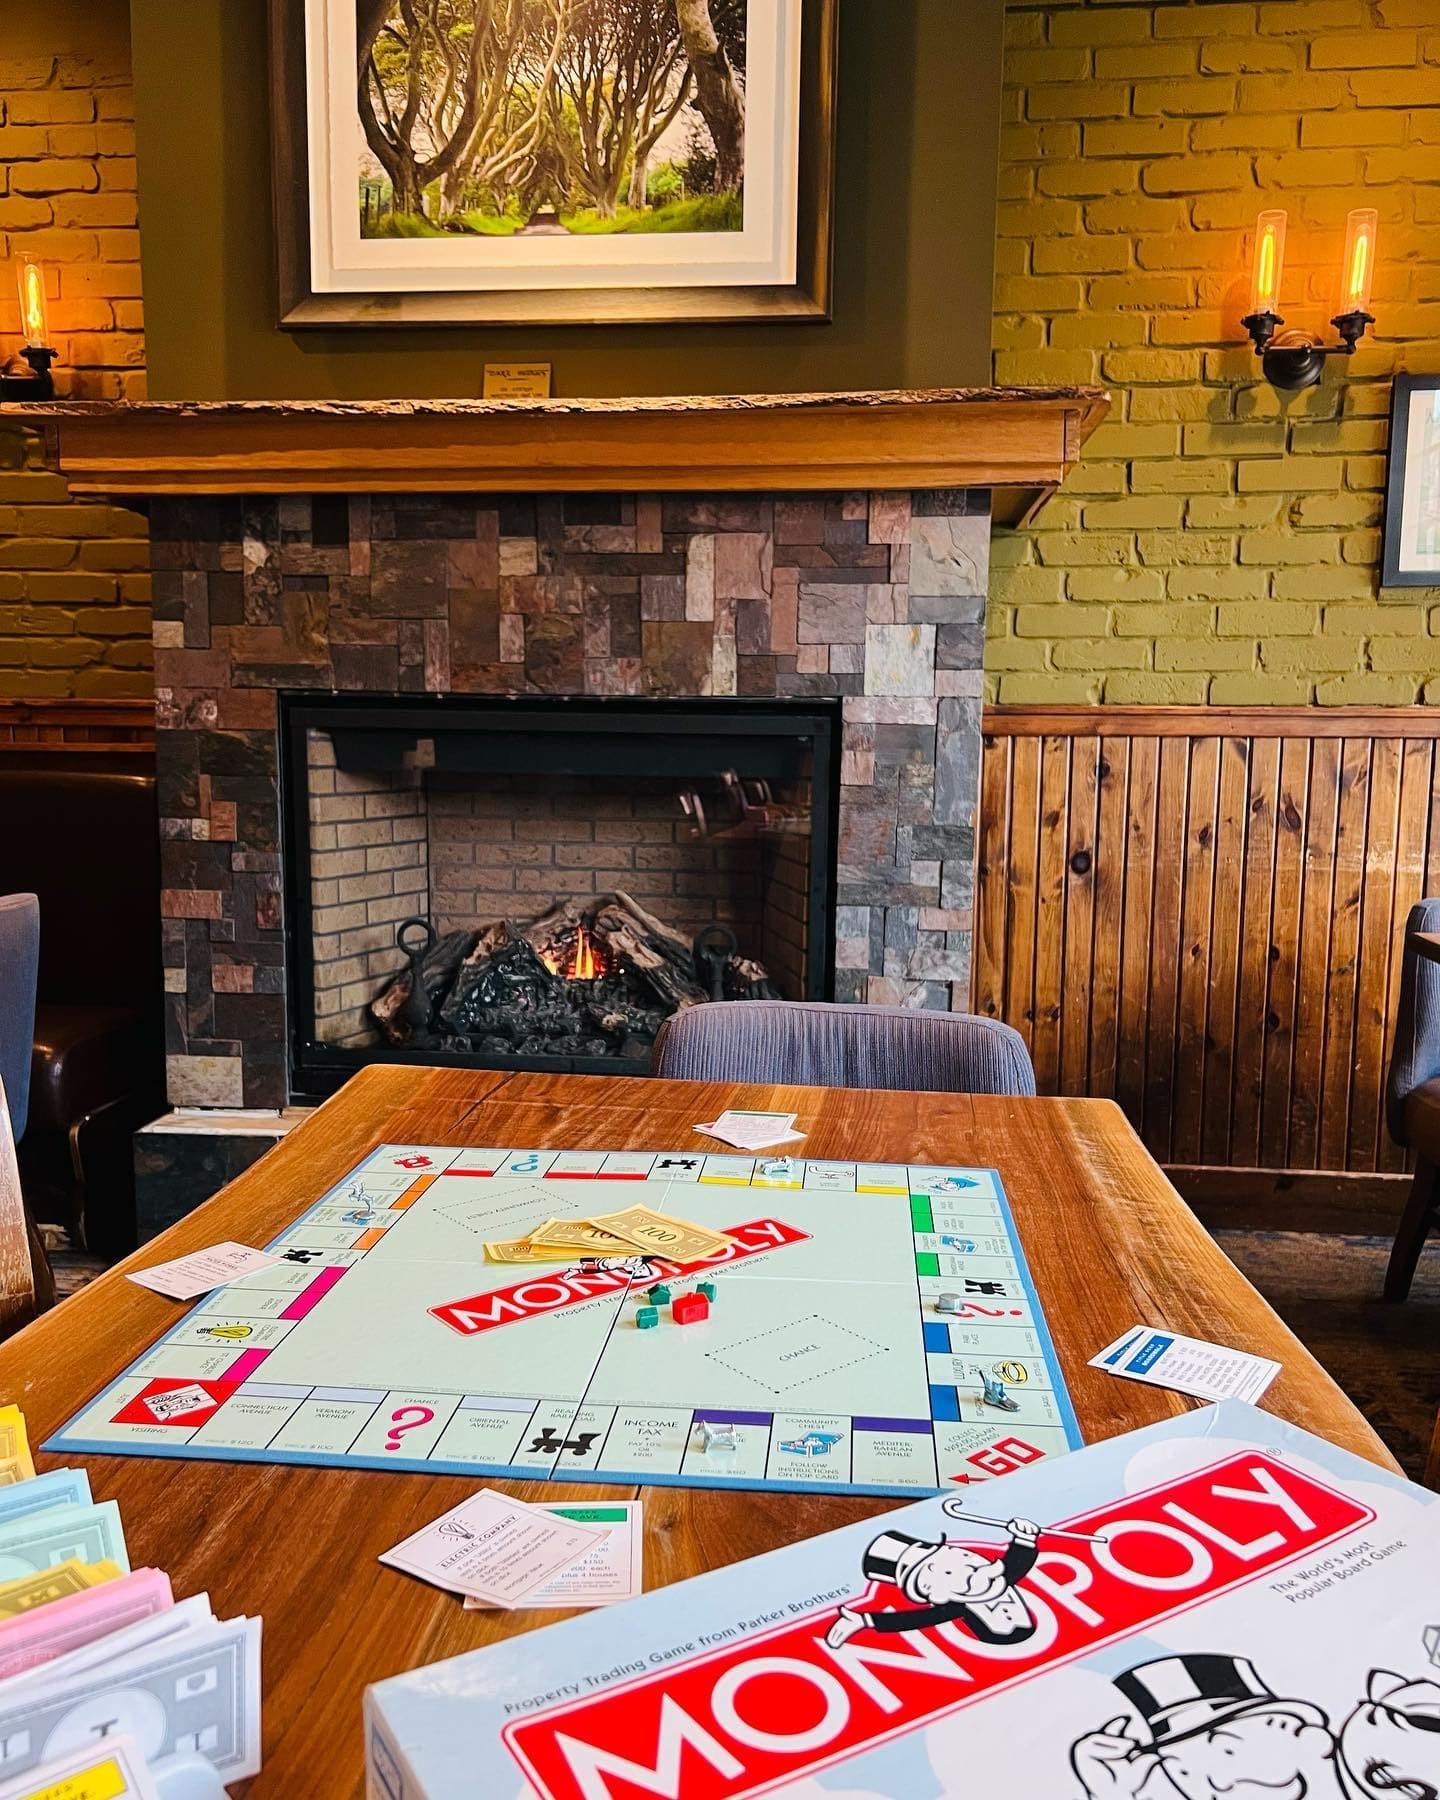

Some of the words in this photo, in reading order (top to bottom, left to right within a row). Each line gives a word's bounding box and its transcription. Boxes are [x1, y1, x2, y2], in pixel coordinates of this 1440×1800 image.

[637, 1225, 677, 1243] 100
[779, 1343, 822, 1362] CHANCE
[404, 1397, 439, 1406] CHANCE
[230, 1402, 290, 1412] CONNECTICUT
[238, 1408, 272, 1416] AVENUE
[315, 1407, 357, 1416] VERMONT
[469, 1416, 511, 1426] ORIENTAL
[624, 1419, 679, 1429] INCOME
[785, 1416, 840, 1426] COMMUNITY
[130, 1426, 168, 1435] VISITING
[470, 1422, 506, 1431] AVENUE
[638, 1428, 662, 1437] TAX
[873, 1445, 914, 1453] RANEAN
[875, 1450, 913, 1458] AVENUE
[965, 1437, 1047, 1476] GO
[790, 1461, 828, 1469] FOLLOW
[777, 1467, 840, 1475] INSTRUCTIONS
[777, 1471, 793, 1479] ON
[794, 1472, 813, 1480] TOP
[439, 1542, 479, 1567] ELECTRIC
[476, 1514, 519, 1542] COMPANY
[1270, 1580, 1299, 1595] The
[1296, 1558, 1345, 1582] World's
[1342, 1540, 1376, 1561] Most
[1285, 1577, 1335, 1604] Popular
[1333, 1558, 1372, 1580] Board
[1370, 1540, 1408, 1561] Game
[553, 1466, 1318, 1800] MONOPOLY
[503, 1682, 580, 1715] Property
[584, 1658, 646, 1688] Trading
[649, 1641, 696, 1663] Game
[698, 1626, 738, 1647] from
[738, 1607, 786, 1632] Parker
